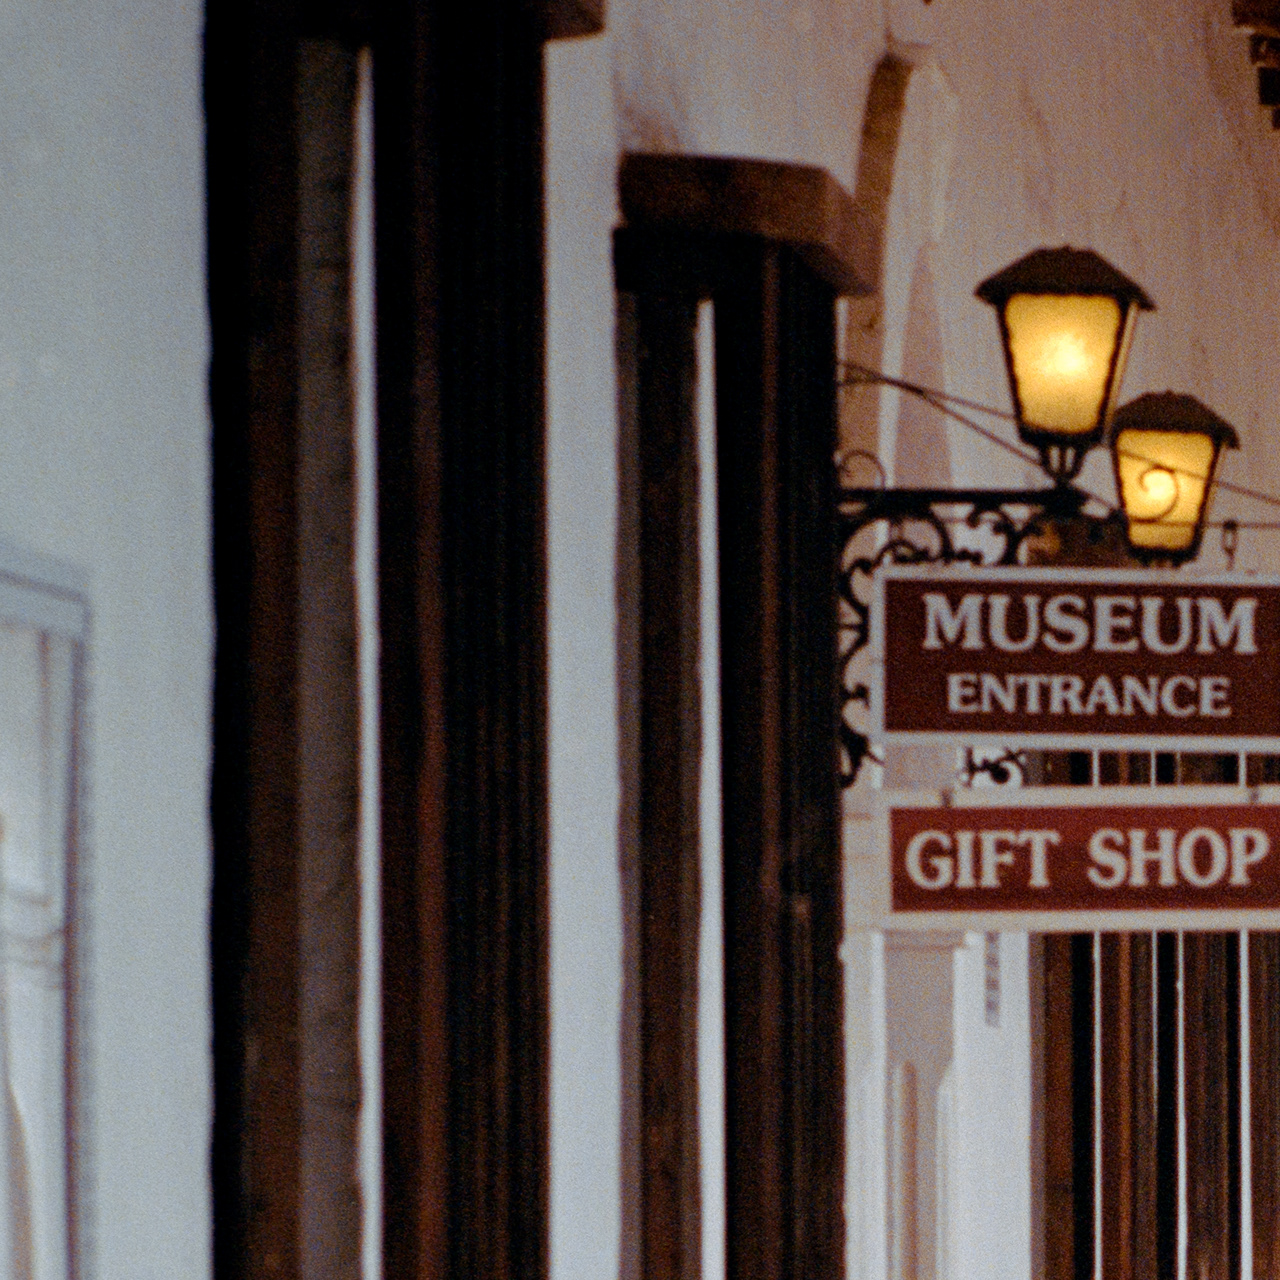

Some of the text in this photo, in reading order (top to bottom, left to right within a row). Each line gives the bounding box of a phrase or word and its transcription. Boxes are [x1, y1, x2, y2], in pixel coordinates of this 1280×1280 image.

[922, 593, 1259, 655] MUSEUM
[946, 673, 1232, 717] ENTRANCE
[905, 827, 1271, 889] GIFT SHOP
